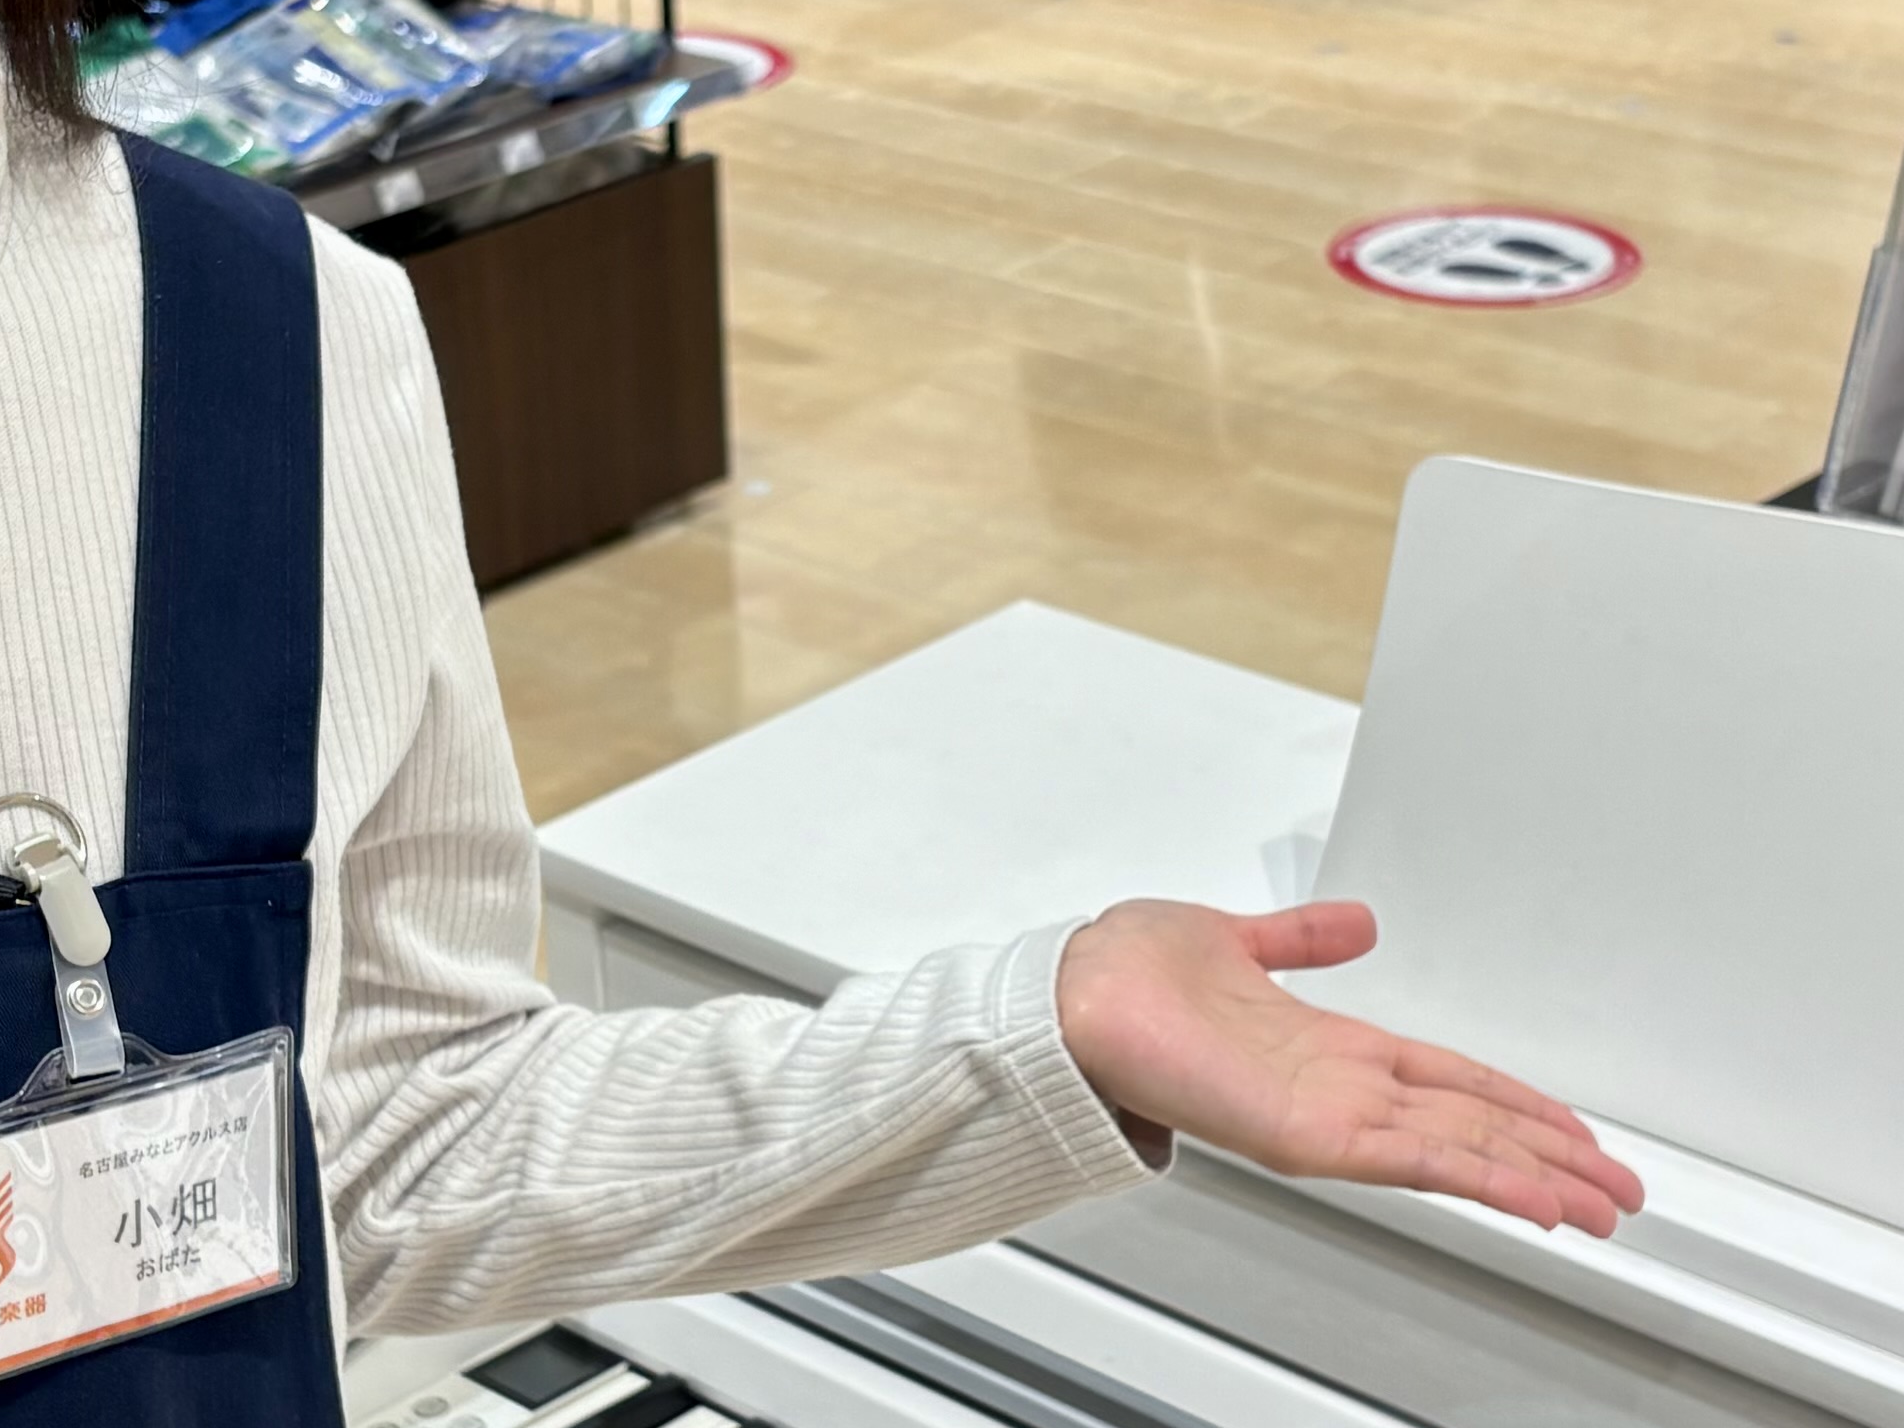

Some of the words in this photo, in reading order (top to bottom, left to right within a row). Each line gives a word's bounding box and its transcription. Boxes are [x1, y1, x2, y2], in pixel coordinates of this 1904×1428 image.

[79, 1116, 248, 1179] 名古屋みなとアクルス店
[114, 1177, 217, 1248] 小畑
[136, 1243, 202, 1281] おばた
